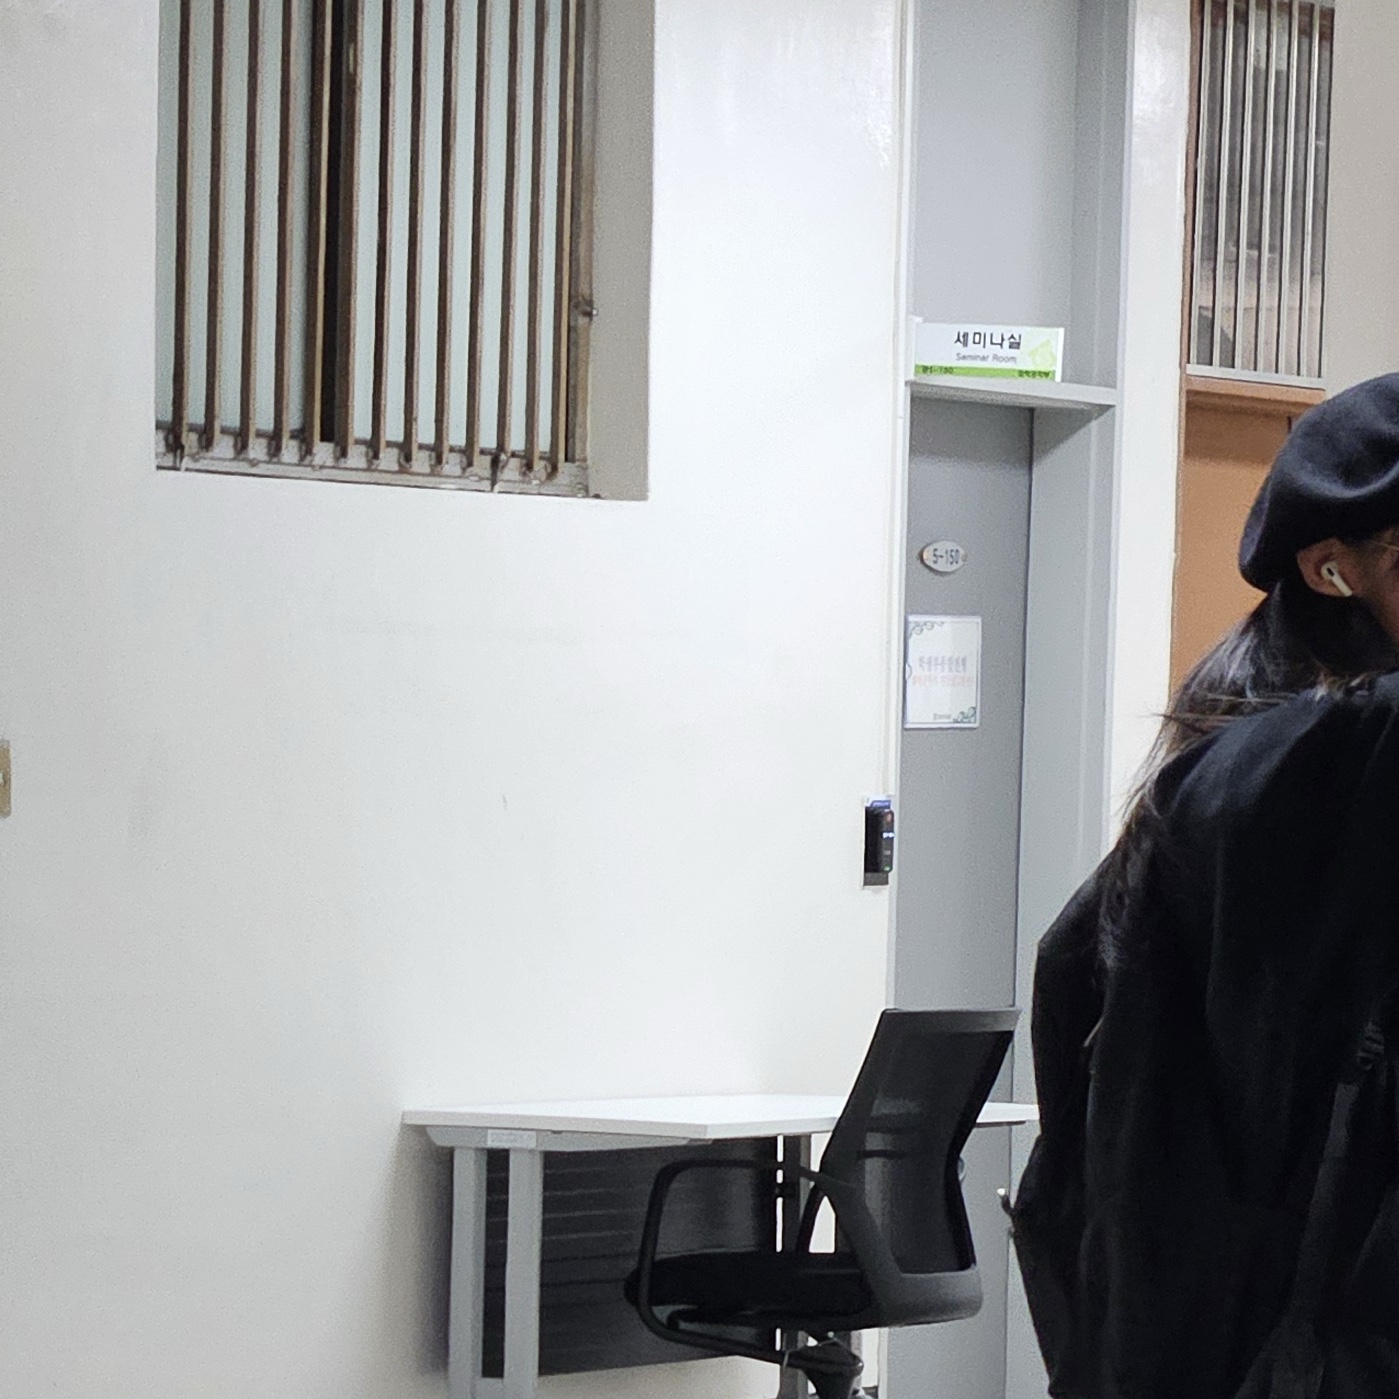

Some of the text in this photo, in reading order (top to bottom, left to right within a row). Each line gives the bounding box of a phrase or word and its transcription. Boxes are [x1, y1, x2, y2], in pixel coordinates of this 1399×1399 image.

[954, 331, 1022, 350] 세미나실
[956, 353, 1017, 364] Seminar Room
[932, 548, 960, 566] 5-150
